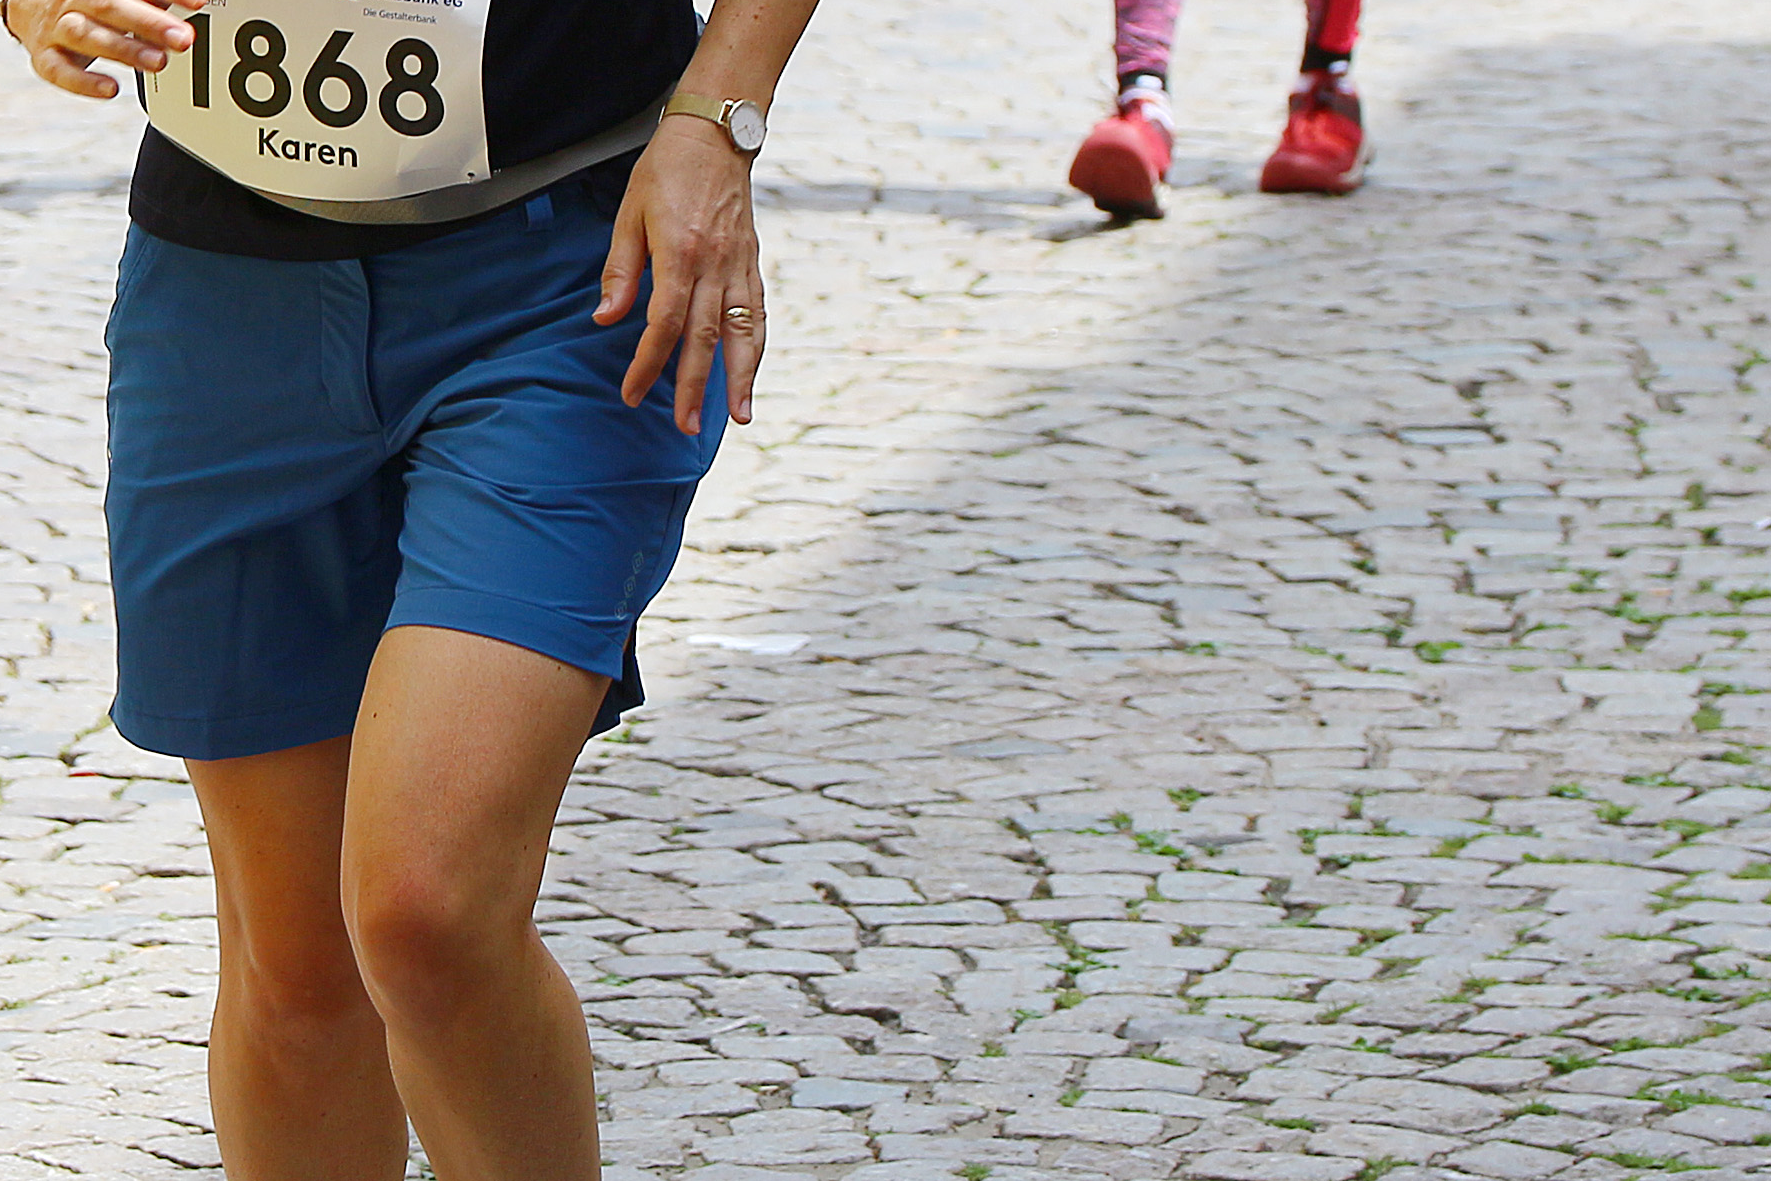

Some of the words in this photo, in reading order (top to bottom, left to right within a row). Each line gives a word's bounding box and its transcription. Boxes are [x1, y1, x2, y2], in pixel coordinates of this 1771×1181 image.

[363, 7, 377, 17] Die
[378, 9, 437, 25] Gestalterbank
[182, 12, 445, 137] 1868
[258, 127, 358, 168] Karen
